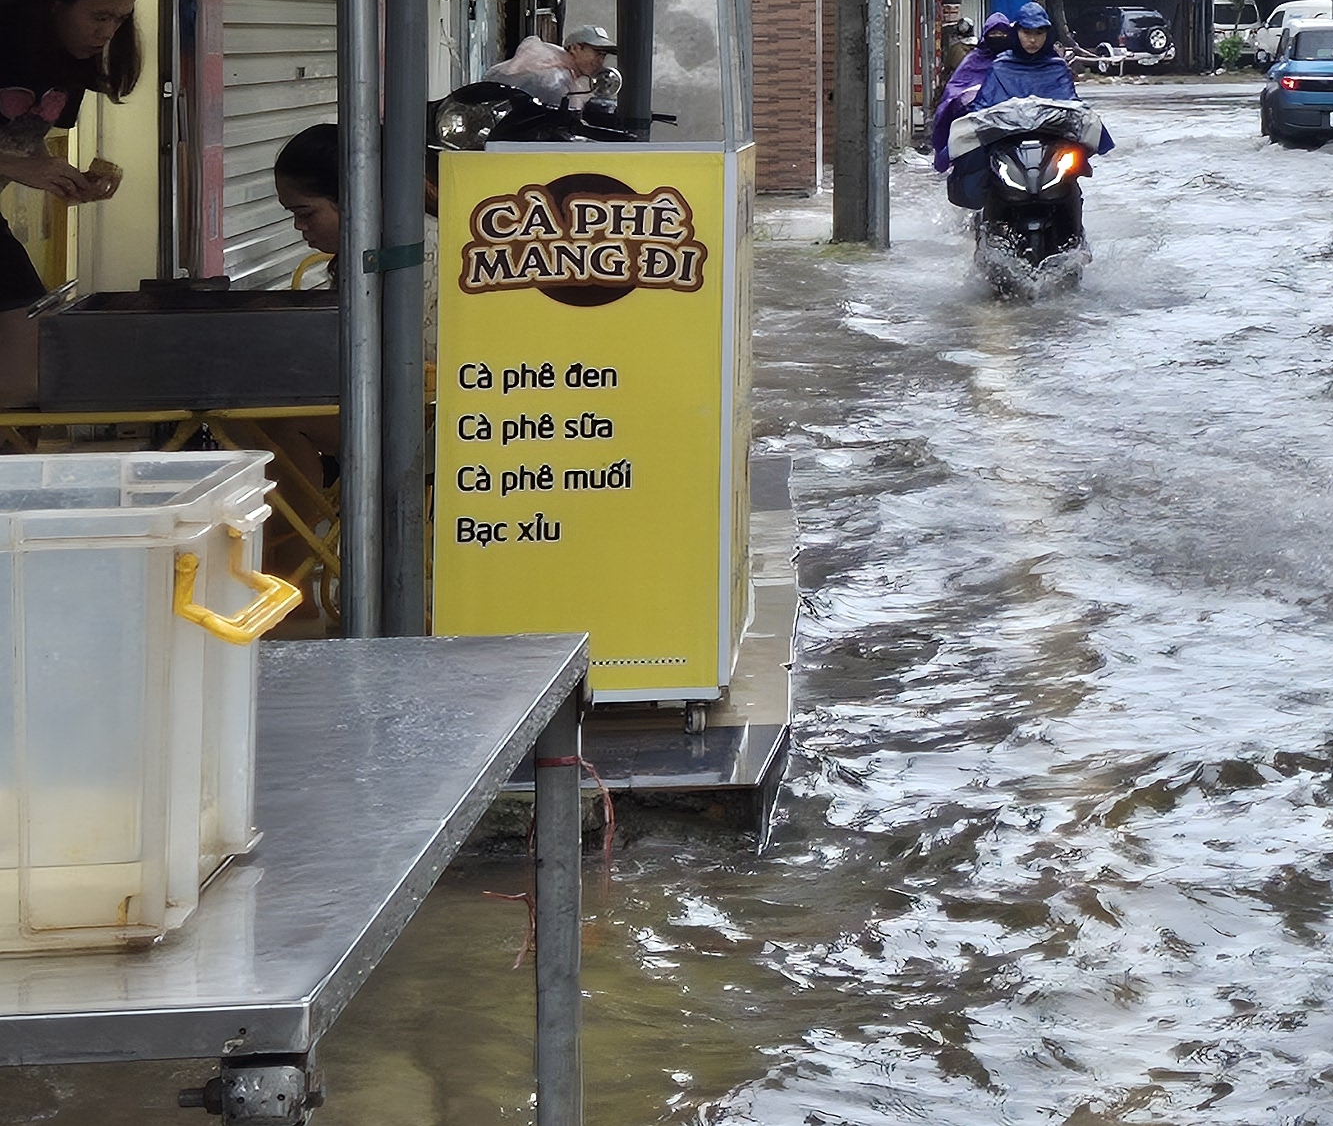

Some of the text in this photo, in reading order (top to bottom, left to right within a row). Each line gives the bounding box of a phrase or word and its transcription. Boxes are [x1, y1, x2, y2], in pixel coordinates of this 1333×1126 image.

[479, 192, 687, 242] CÀ PHÊ
[469, 243, 697, 285] MANG ĐI
[459, 362, 617, 394] Cà phê đen
[458, 412, 613, 445] Cà phê sữa
[457, 458, 632, 497] Cà phê muối
[456, 512, 561, 547] Bạc xỉu
